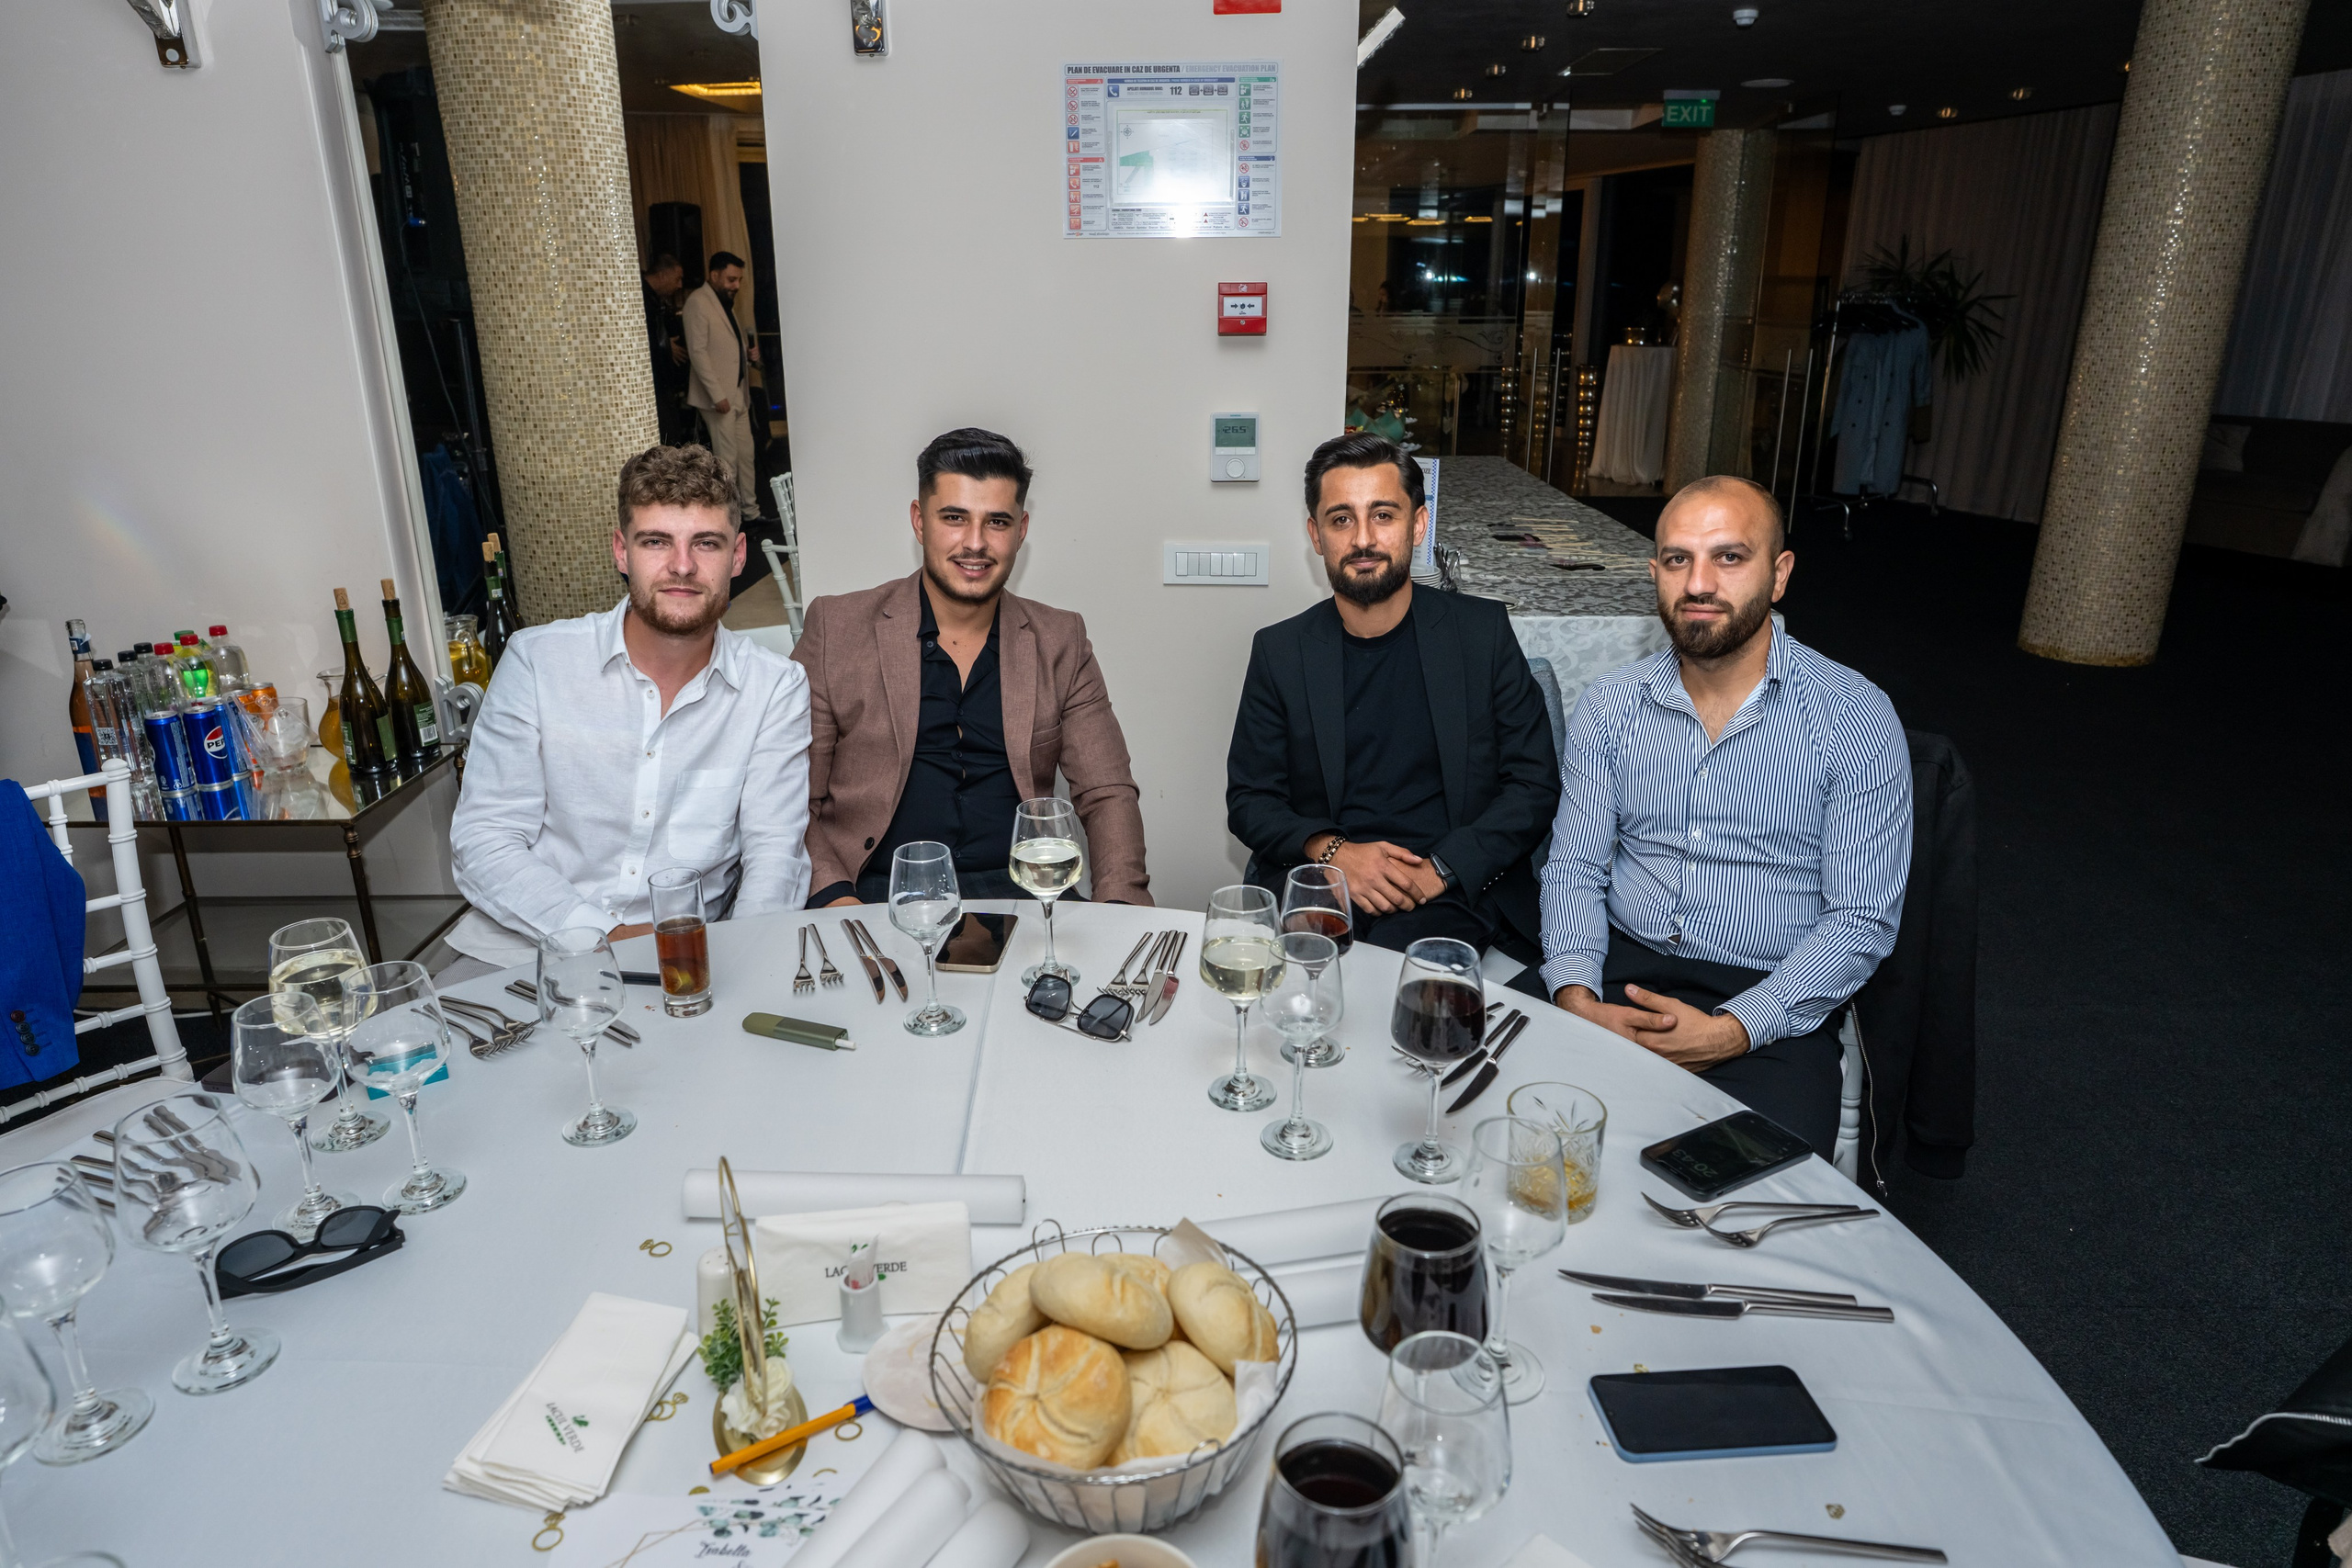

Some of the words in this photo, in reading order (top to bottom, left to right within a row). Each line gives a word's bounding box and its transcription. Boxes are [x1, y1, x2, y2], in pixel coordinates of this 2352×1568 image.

[1132, 65, 1143, 73] CAZ
[1145, 65, 1152, 73] DE
[1153, 65, 1180, 73] URGENTA
[1186, 64, 1221, 73] EMERGENCY
[1222, 64, 1259, 73] EVACUATION
[1170, 86, 1182, 95] 112
[1667, 106, 1711, 122] EXIT
[546, 1402, 568, 1425] LACUL
[562, 1424, 585, 1453] VERDE
